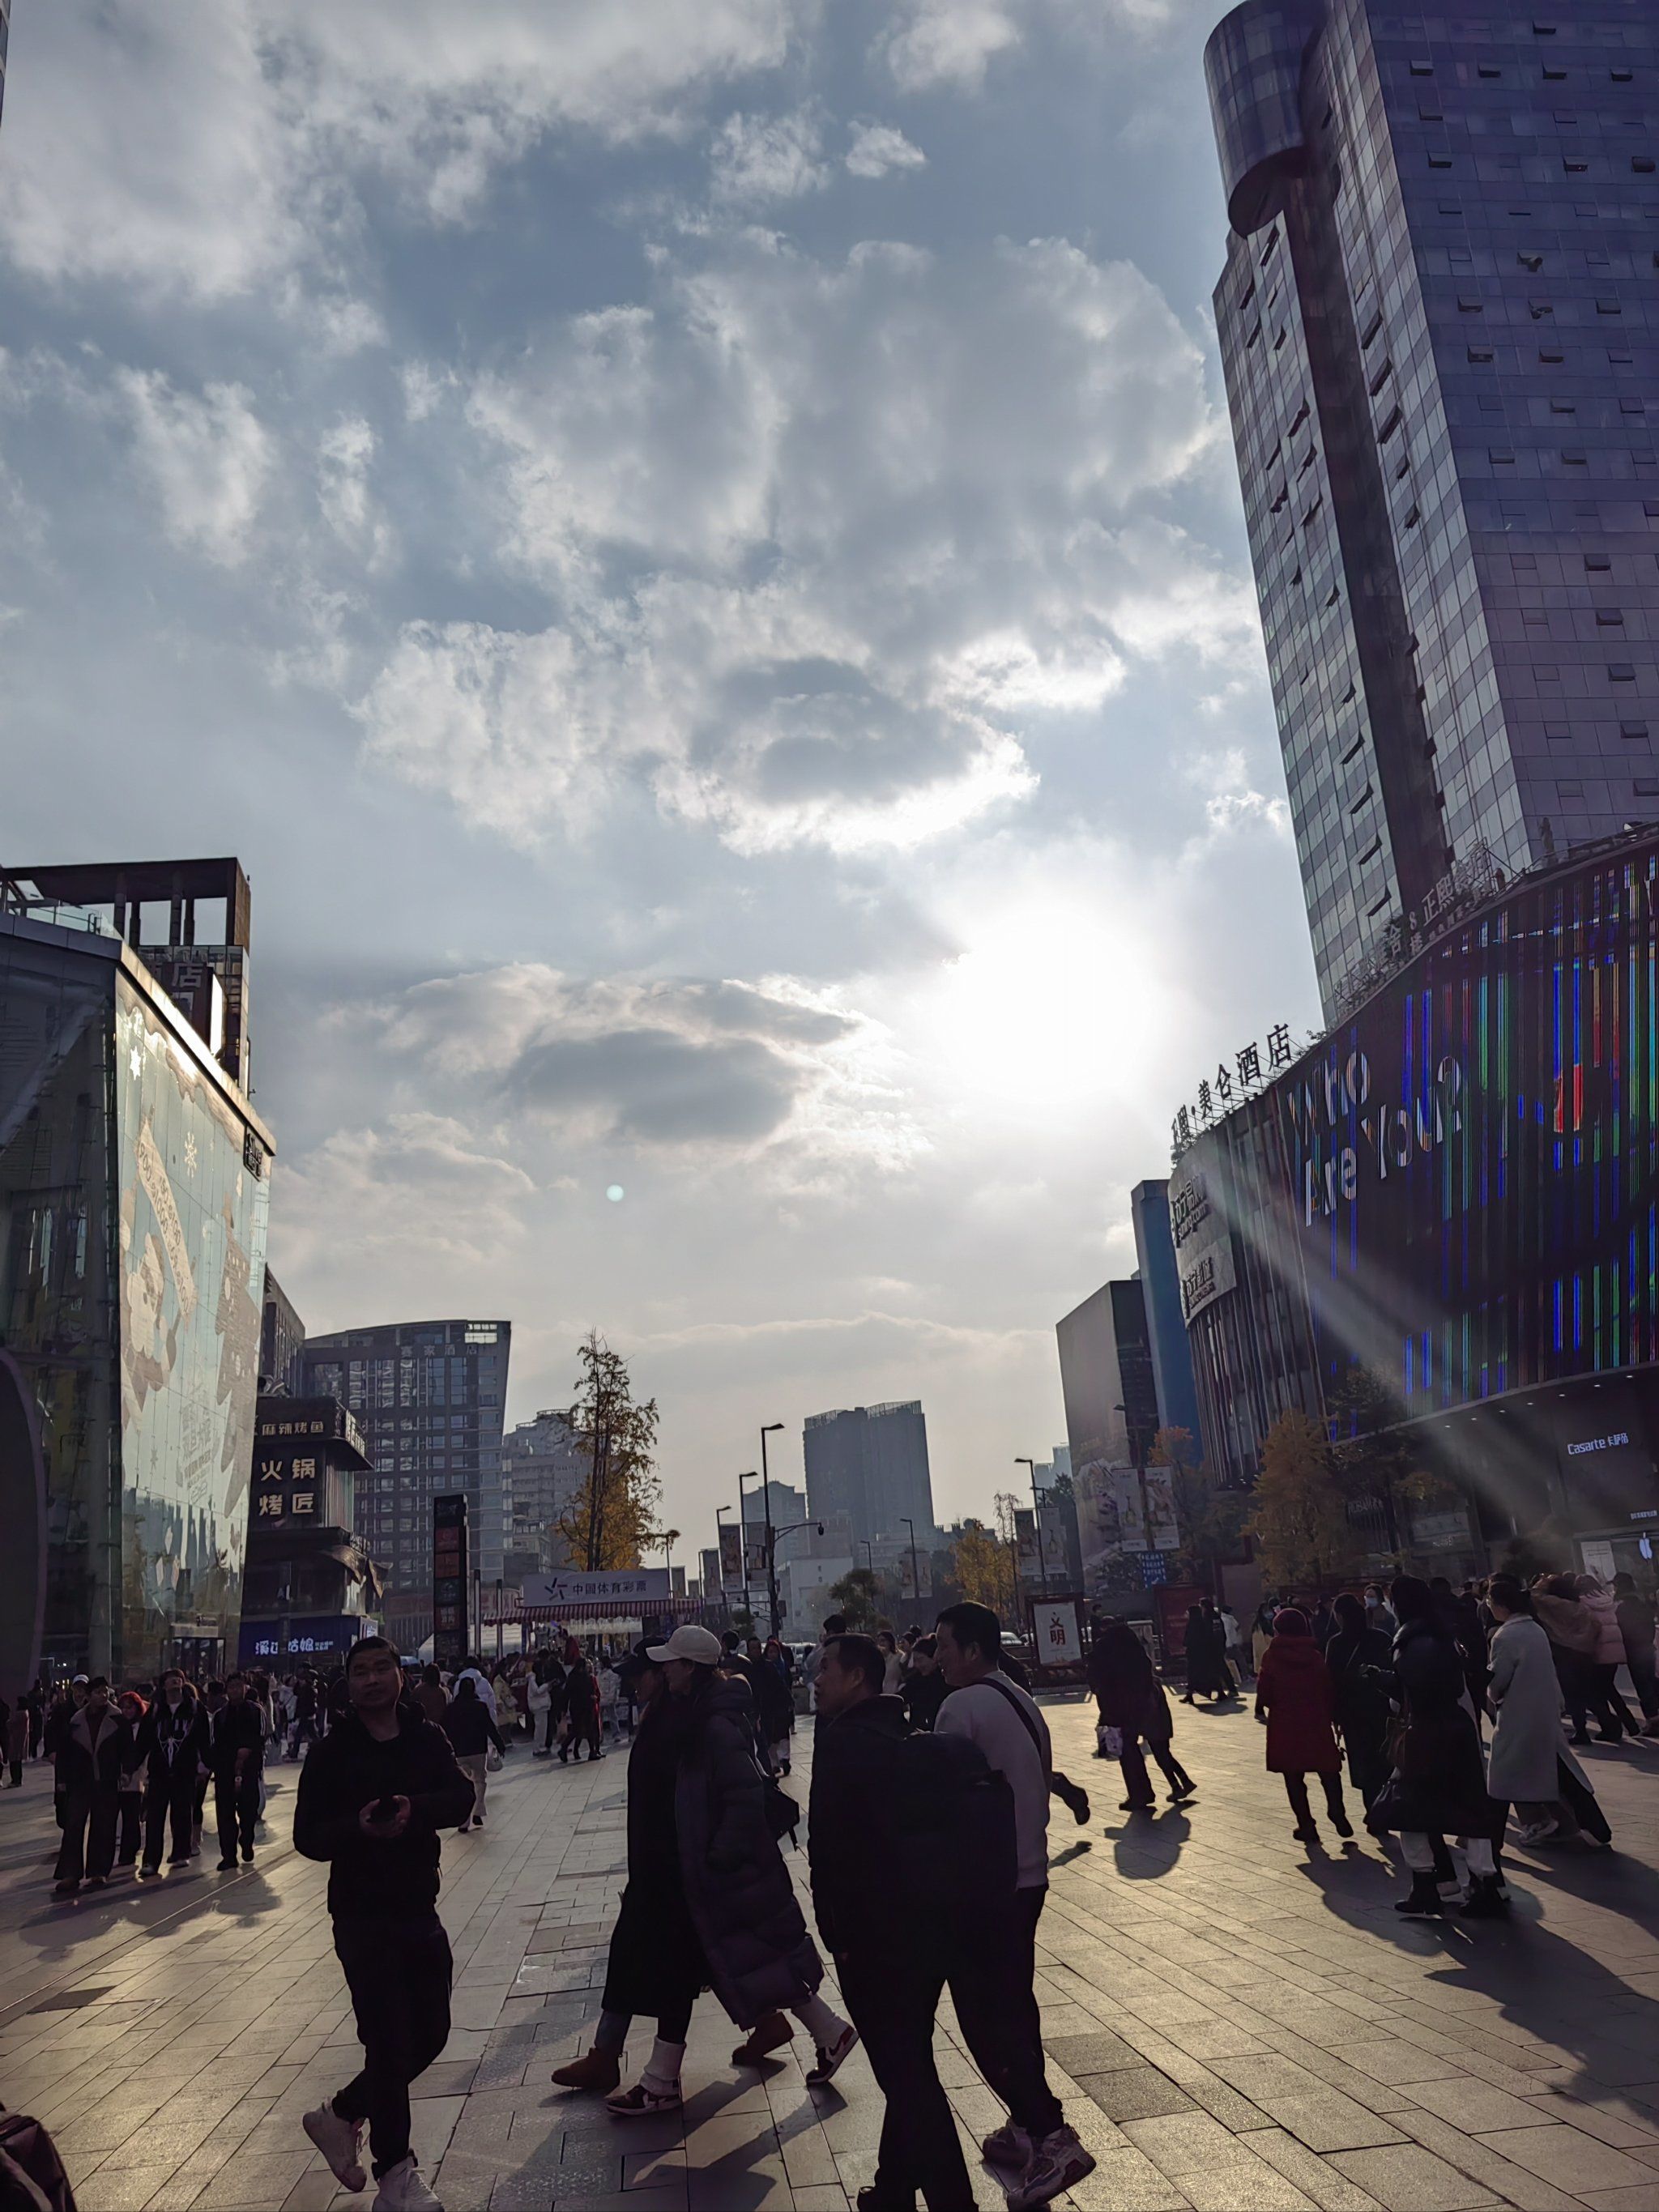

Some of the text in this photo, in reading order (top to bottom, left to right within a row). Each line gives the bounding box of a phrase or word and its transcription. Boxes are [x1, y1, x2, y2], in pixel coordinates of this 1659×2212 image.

[1287, 1051, 1371, 1146] Who
[1305, 1055, 1463, 1228] Are You?
[262, 1421, 324, 1437] 麻辣烤鱼
[1567, 1438, 1607, 1455] Casarte
[260, 1458, 316, 1481] 火锅
[258, 1493, 315, 1516] 烤匠
[573, 1580, 647, 1595] 中国体育彩票
